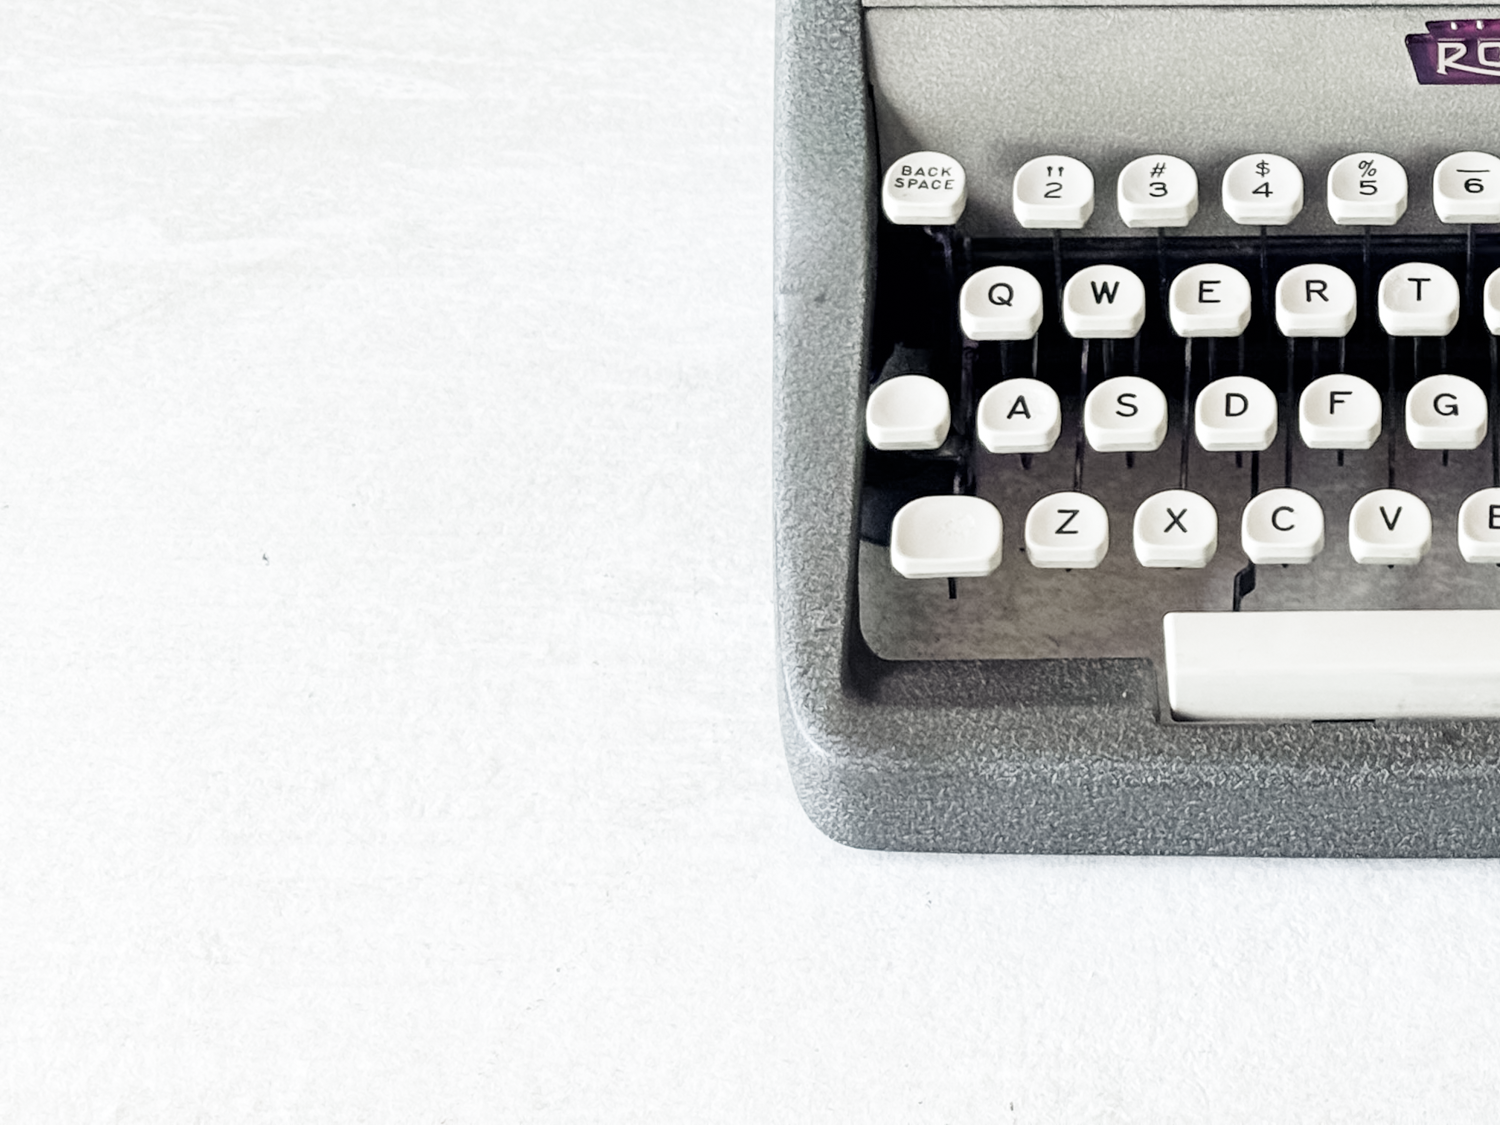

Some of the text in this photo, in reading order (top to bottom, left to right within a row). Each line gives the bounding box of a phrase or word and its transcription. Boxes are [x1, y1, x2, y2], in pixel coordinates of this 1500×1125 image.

[901, 165, 950, 177] BACK
[1150, 163, 1166, 178] #
[1255, 159, 1270, 178] $
[1358, 159, 1377, 178] %
[894, 177, 953, 190] SPACE
[1043, 182, 1063, 199] 2
[1149, 181, 1168, 198] 3
[1251, 181, 1274, 198] 4
[1359, 180, 1378, 196] 5
[1463, 177, 1485, 194] 6
[987, 282, 1014, 307] Q
[1090, 280, 1120, 305] W
[1198, 280, 1222, 304] E
[1305, 279, 1329, 303] R
[1407, 277, 1432, 302] T
[1006, 395, 1032, 420] A
[1115, 392, 1139, 418] S
[1224, 392, 1249, 417] D
[1329, 390, 1353, 415] F
[1432, 392, 1459, 417] G
[1054, 509, 1080, 535] Z
[1163, 507, 1188, 533] X
[1271, 505, 1295, 532] C
[1379, 506, 1402, 531] V
